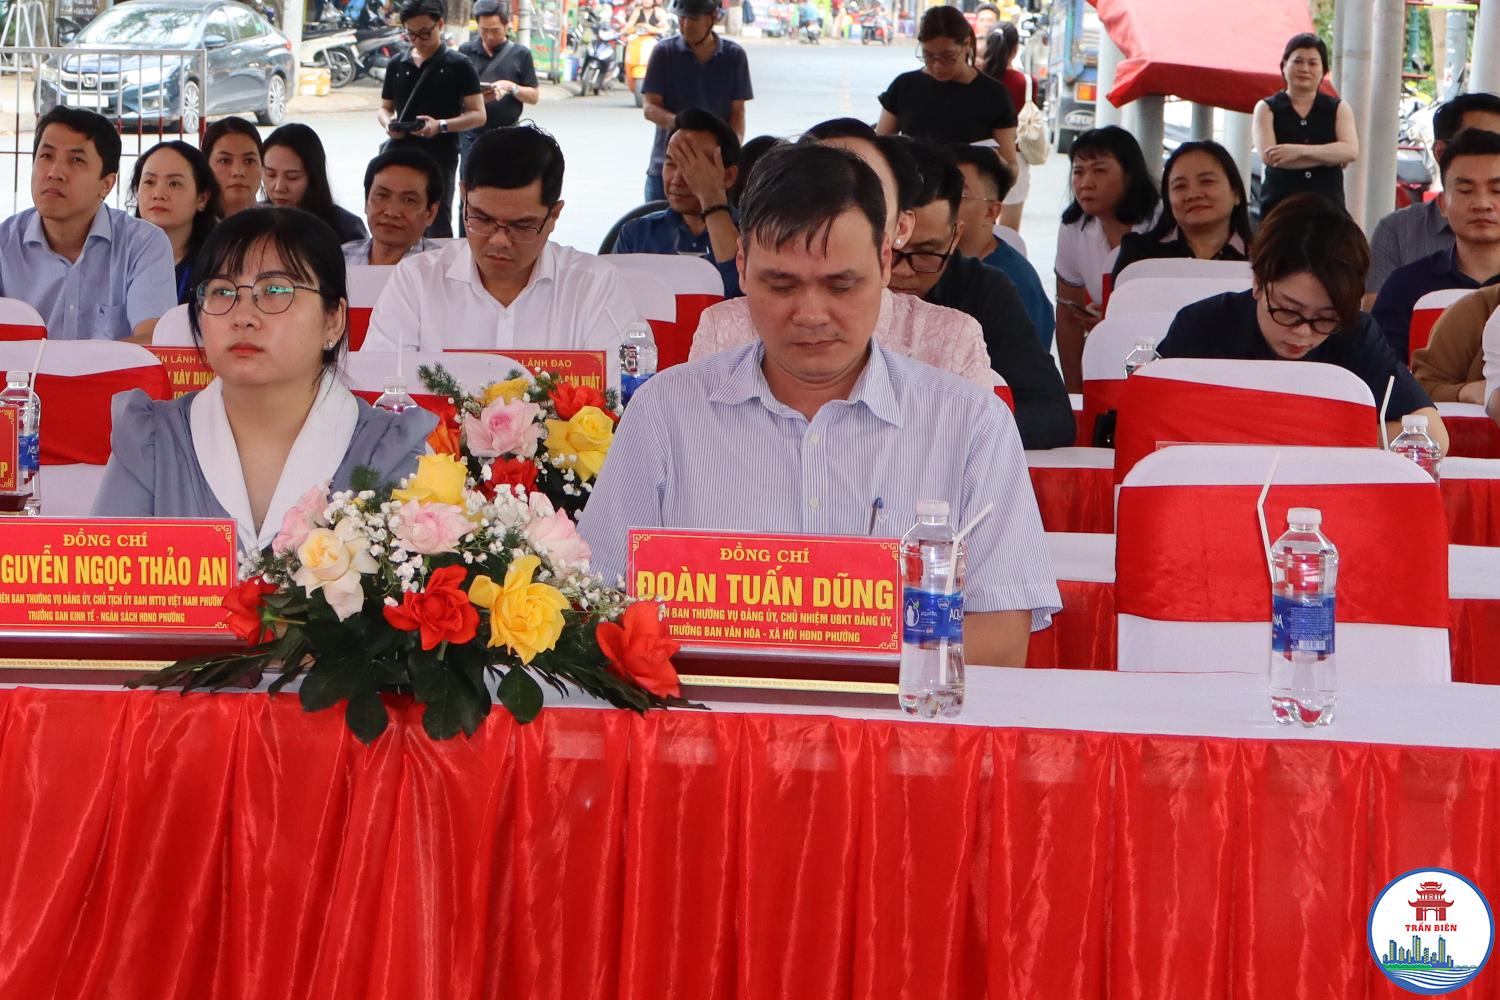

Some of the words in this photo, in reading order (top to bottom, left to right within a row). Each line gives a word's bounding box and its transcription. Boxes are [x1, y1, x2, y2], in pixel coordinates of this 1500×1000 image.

[171, 353, 196, 364] LÃNH
[521, 358, 548, 368] LÃNH
[551, 359, 573, 369] ĐẠO
[173, 369, 191, 385] XÂY
[62, 527, 112, 547] ĐỒNG
[116, 531, 148, 547] CHÍ
[719, 542, 771, 562] ĐỒNG
[776, 547, 810, 563] CHÍ
[75, 555, 132, 591] NGỌC
[137, 546, 192, 586] THẢO
[197, 556, 227, 586] AN
[636, 565, 717, 603] ĐOÀN
[725, 565, 803, 607] TUẤN
[813, 572, 894, 610] DŨNG
[11, 593, 25, 604] BAN
[26, 591, 52, 605] THƯỜNG
[53, 594, 62, 606] VỤ
[63, 591, 81, 605] ĐẢNG
[82, 591, 92, 606] ỦY,
[93, 591, 106, 605] CHỦ
[108, 595, 122, 607] TỊCH
[123, 592, 132, 606] ỦY
[134, 595, 148, 606] BAN
[148, 595, 166, 607] MTTQ
[167, 594, 181, 608] VIỆT
[182, 596, 198, 606] NAM
[28, 607, 54, 621] TRƯỞNG
[54, 611, 69, 621] BAN
[70, 611, 86, 622] KINH
[87, 608, 95, 622] TẾ
[100, 610, 119, 622] NGÂN
[120, 610, 138, 622] SÁCH
[139, 612, 157, 622] HĐND
[159, 610, 186, 623] PHƯỜNG
[672, 608, 690, 619] BAN
[691, 606, 725, 620] THƯỜNG
[727, 610, 738, 623] VỤ
[740, 607, 764, 622] ĐẢNG
[766, 608, 778, 623] ỦY,
[780, 609, 798, 623] CHỦ
[800, 611, 828, 626] NHIỆM
[830, 614, 852, 625] UBKT
[854, 612, 878, 626] ĐẢNG
[880, 613, 893, 627] ỦY,
[669, 622, 702, 636] TRƯỞNG
[704, 626, 722, 637] BAN
[724, 625, 742, 638] VĂN
[743, 625, 761, 639] HÓA
[769, 627, 781, 640] XÃ
[782, 627, 797, 642] HỘI
[799, 629, 823, 641] HĐND
[825, 629, 860, 643] PHƯỜNG
